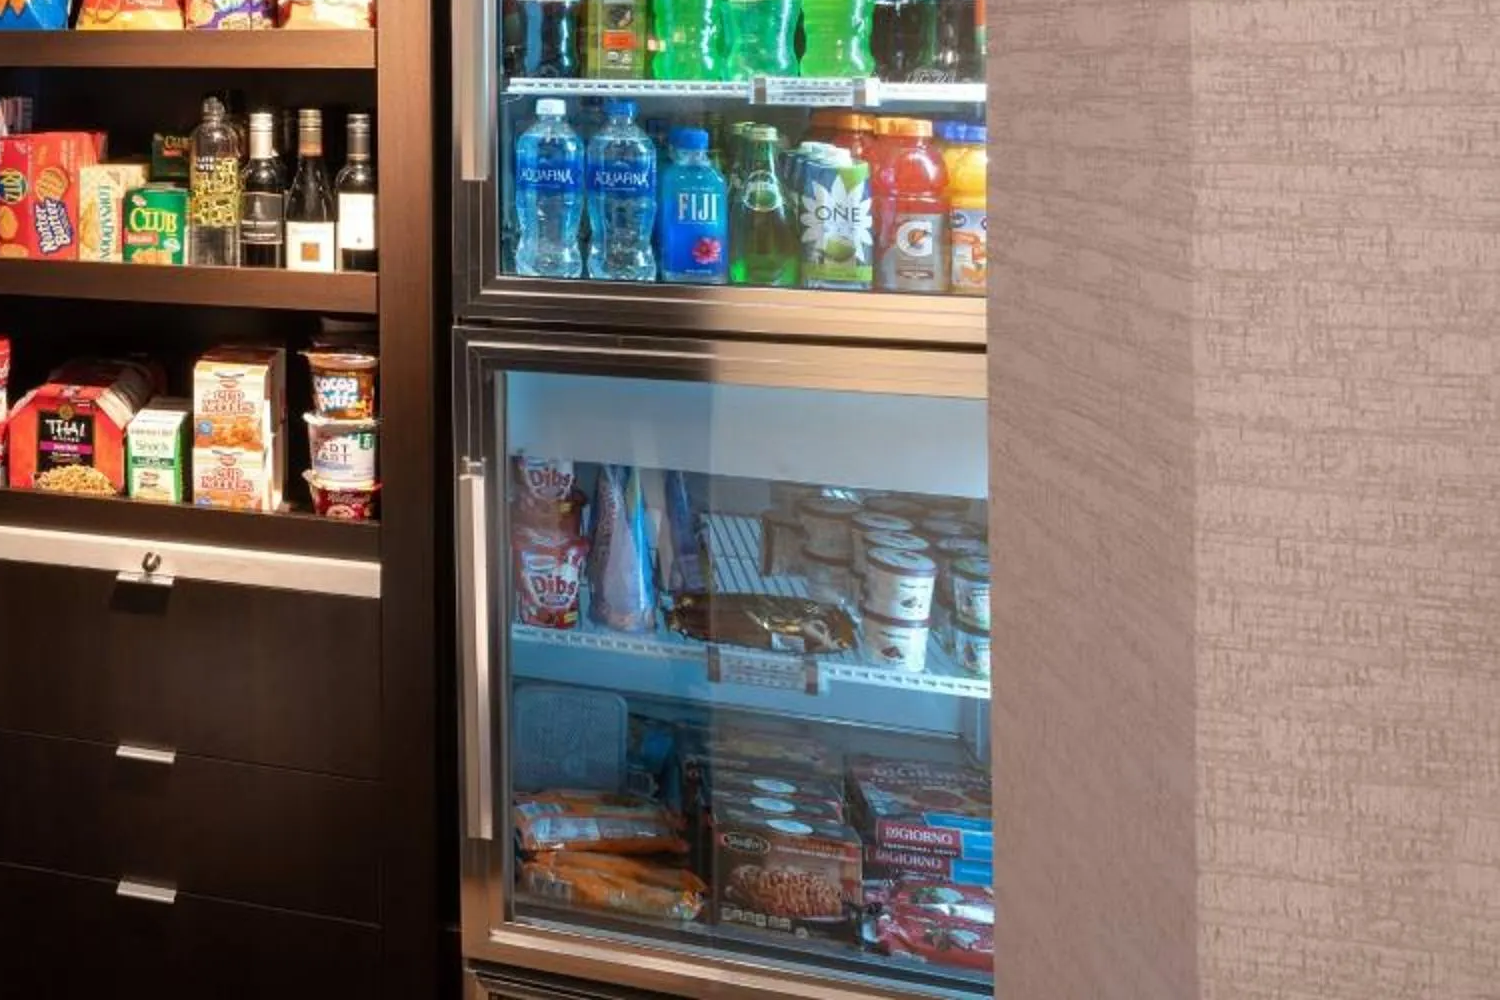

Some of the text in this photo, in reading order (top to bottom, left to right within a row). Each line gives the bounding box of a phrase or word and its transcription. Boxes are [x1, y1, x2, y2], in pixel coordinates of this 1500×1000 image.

[2, 171, 21, 202] RITZ
[518, 168, 575, 186] AQUAFINA
[594, 170, 650, 188] AQUAFINA
[677, 193, 720, 222] FIJI
[130, 207, 178, 233] CLUB
[45, 419, 86, 438] THAI
[529, 467, 572, 487] Dibs
[530, 574, 576, 596] Dibs
